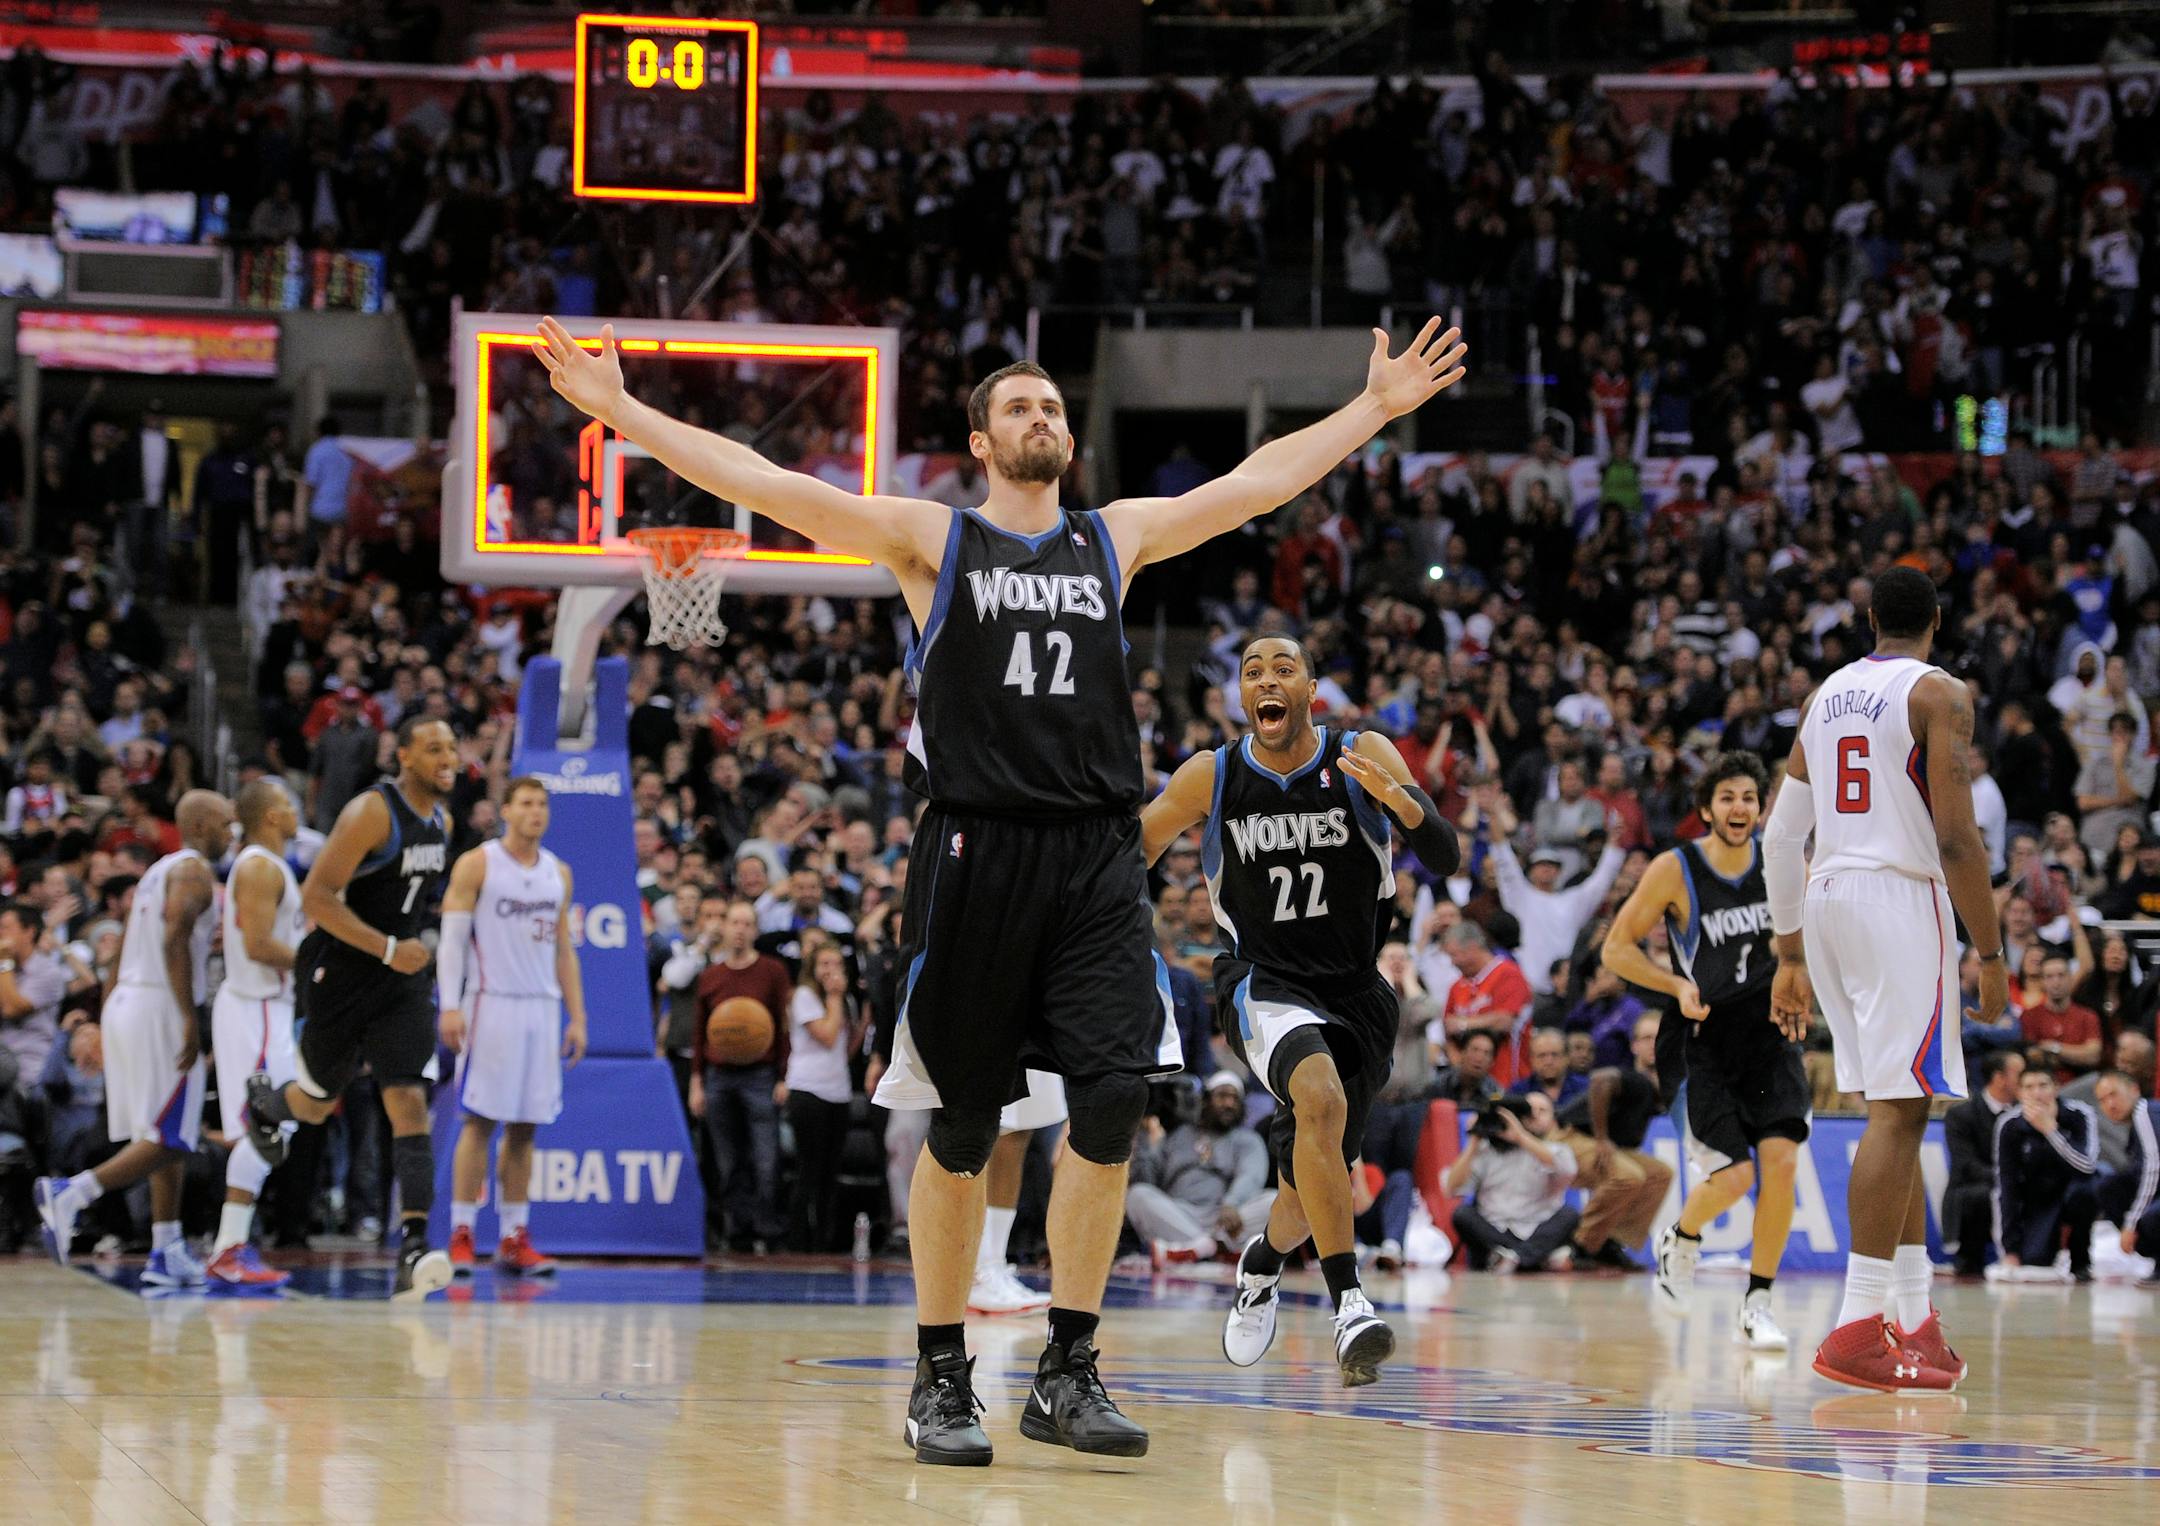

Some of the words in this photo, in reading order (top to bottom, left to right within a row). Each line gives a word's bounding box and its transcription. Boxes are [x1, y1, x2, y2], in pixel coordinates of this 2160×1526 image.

[627, 38, 704, 90] 0.0
[965, 567, 1107, 623] WOLVES
[1003, 630, 1075, 696] 42
[1823, 690, 1888, 723] JORDAN
[1836, 735, 1870, 813] 6
[1225, 807, 1350, 865] WOLVES
[1268, 861, 1329, 922] 22
[1701, 901, 1773, 948] WOLVE
[616, 1150, 684, 1204] TV
